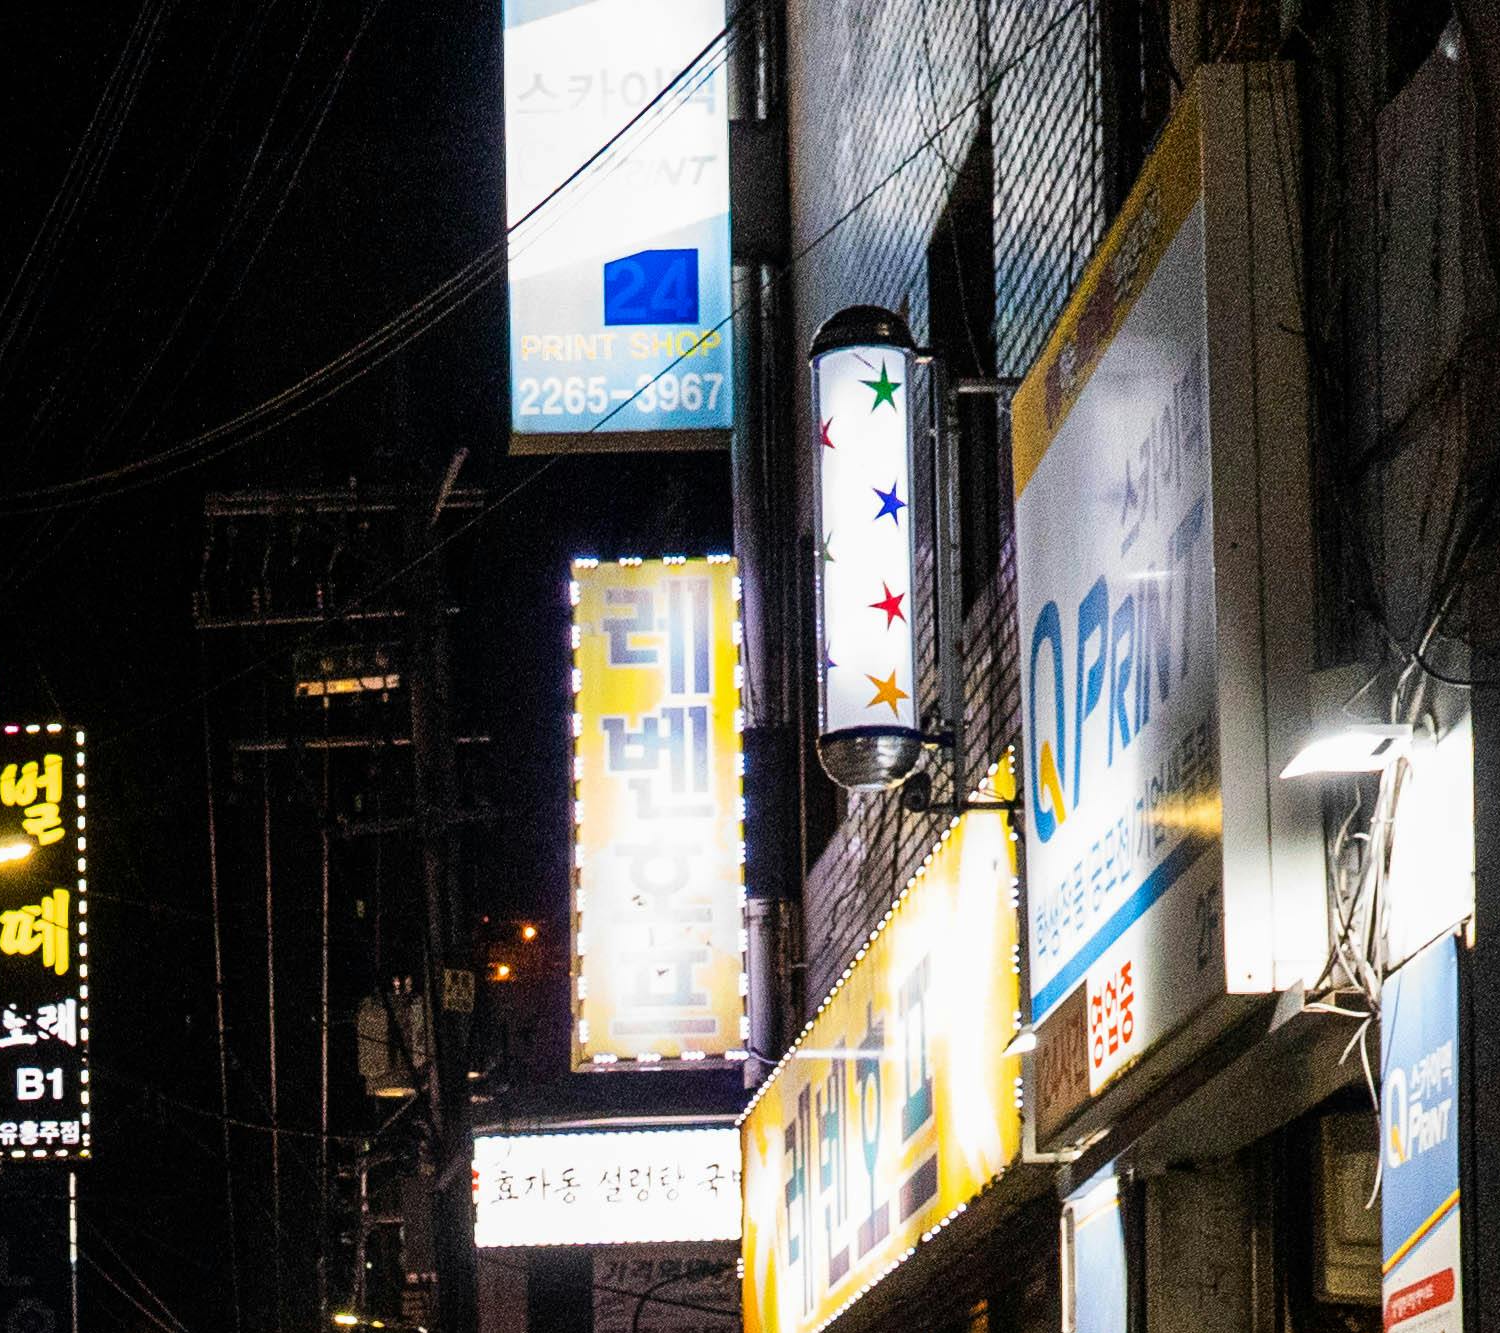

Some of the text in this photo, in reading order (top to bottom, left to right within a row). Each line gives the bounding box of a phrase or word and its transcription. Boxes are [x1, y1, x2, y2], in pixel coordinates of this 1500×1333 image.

[521, 331, 722, 360] PRINT SHOP
[519, 373, 724, 416] 2265-3967
[16, 1067, 65, 1101] B1
[490, 1168, 581, 1204] 효자동
[599, 1164, 686, 1203] 설렁탕
